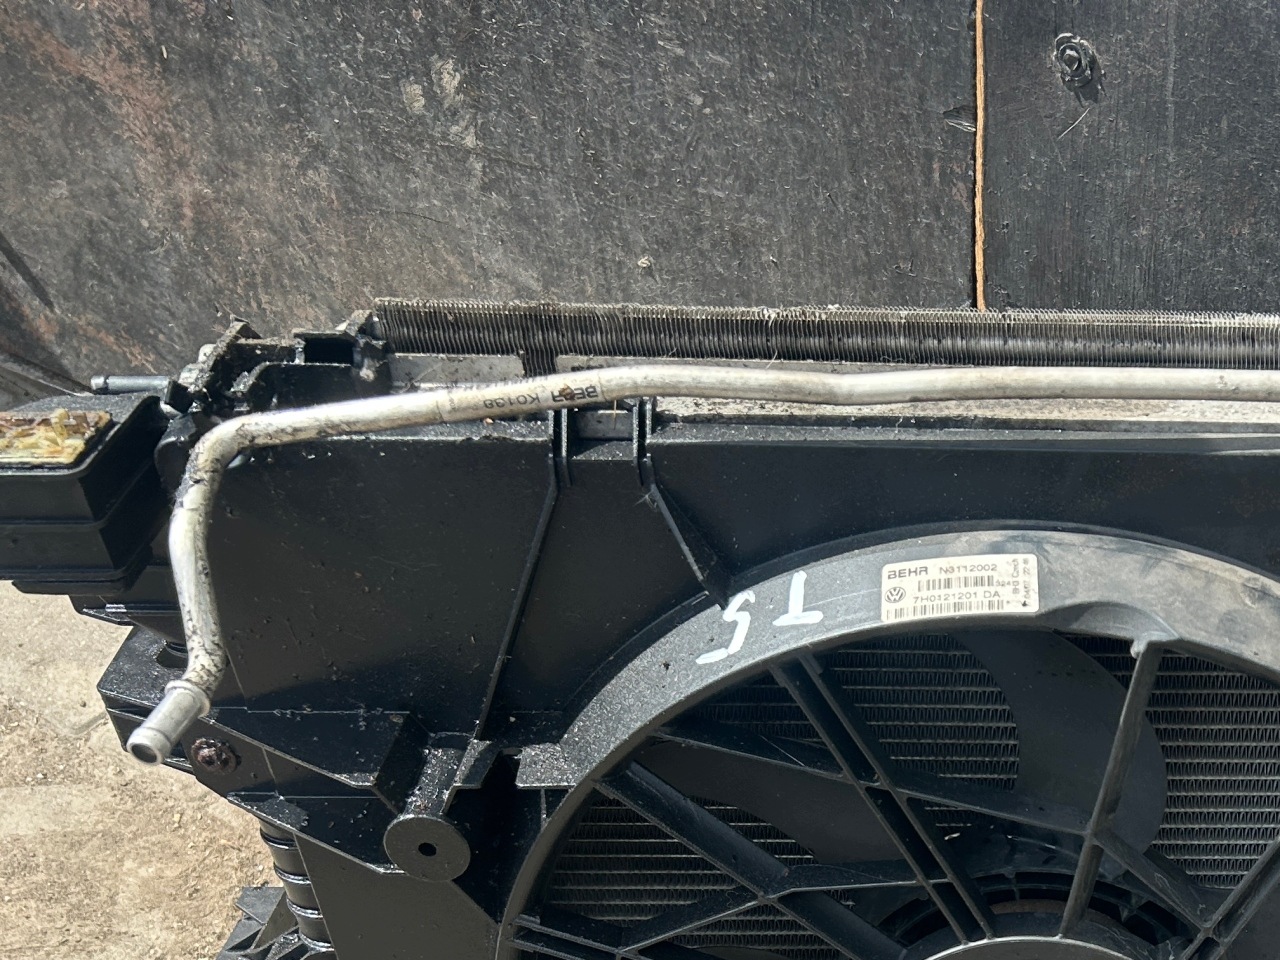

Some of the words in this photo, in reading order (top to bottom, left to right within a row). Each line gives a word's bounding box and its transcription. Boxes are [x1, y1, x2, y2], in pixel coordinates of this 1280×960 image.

[887, 566, 928, 580] BEHR
[913, 591, 978, 604] 7H0121201
[983, 590, 1001, 599] DA
